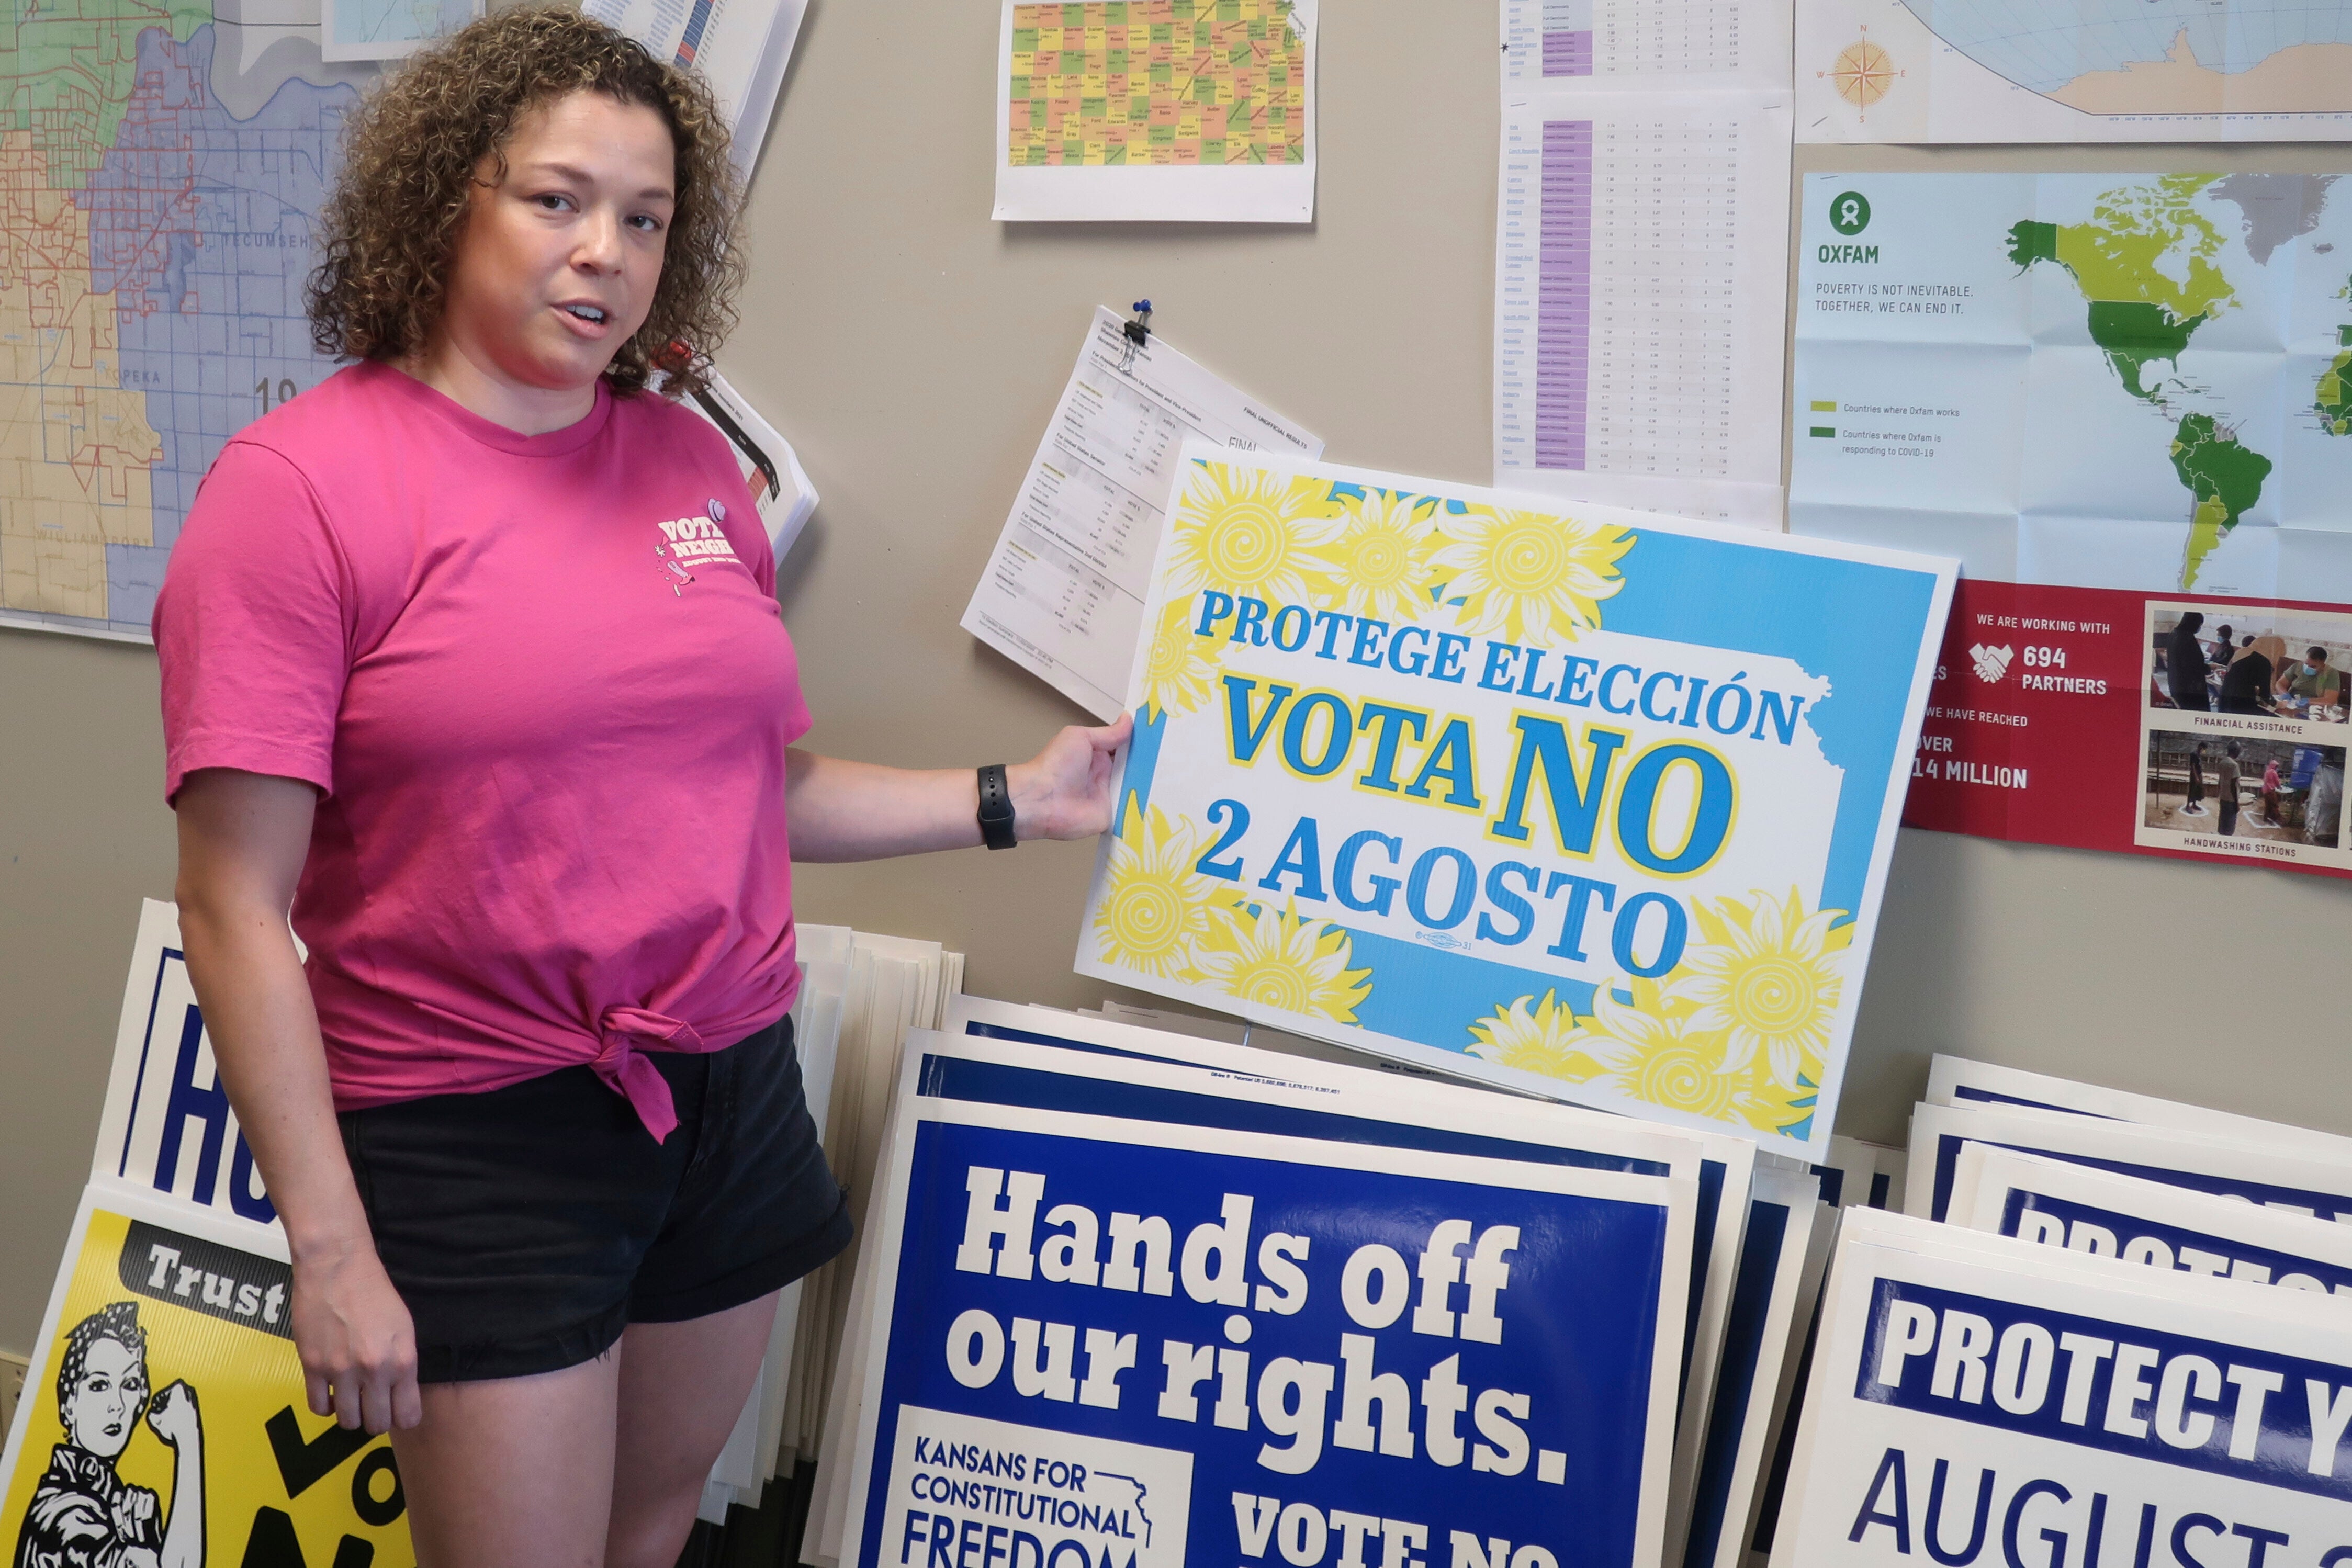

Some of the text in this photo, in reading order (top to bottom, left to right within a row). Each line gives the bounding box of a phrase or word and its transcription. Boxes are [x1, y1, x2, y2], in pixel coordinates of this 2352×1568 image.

[223, 233, 308, 248] TECUMSEH
[1818, 244, 1879, 264] OXFAM
[1816, 283, 1974, 297] POVERTY IS NOT INEVITABLE.
[1815, 300, 1964, 314] TOGETHER, WE CAN END IT.
[1844, 404, 1960, 417] Countries where Oxfam works
[1243, 406, 1308, 449] FINAL UNOFFICIAL RESULTS
[1843, 430, 1941, 443] Countries where Oxfam is
[1842, 446, 1886, 457] responding
[1898, 447, 1934, 457] COVID-19
[1977, 614, 2110, 634] WE ARE WORKING WITH
[1194, 590, 1805, 747] PROTEGE ELECCIÓN
[2023, 646, 2066, 669] 694
[2022, 674, 2107, 695] PARTNERS
[1926, 707, 2028, 727] WE HAVE REACHED
[2195, 717, 2302, 734] FINANCIAL ASSISTANCE
[1220, 671, 1738, 878] VOTA NO
[1945, 760, 2027, 789] MILLION
[2184, 838, 2297, 857] HANDWASHING STATIONS
[1196, 798, 1690, 978] 2 AGOSTO
[956, 1166, 1521, 1346] Hands off
[148, 1244, 285, 1324] Trust
[1877, 1298, 2284, 1462] PROTECT
[944, 1308, 1569, 1487] our rights.
[914, 1435, 1087, 1494] KANSANS FOR
[911, 1472, 1137, 1538] CONSTITUTIONAL
[1232, 1492, 1429, 1568] VOTE
